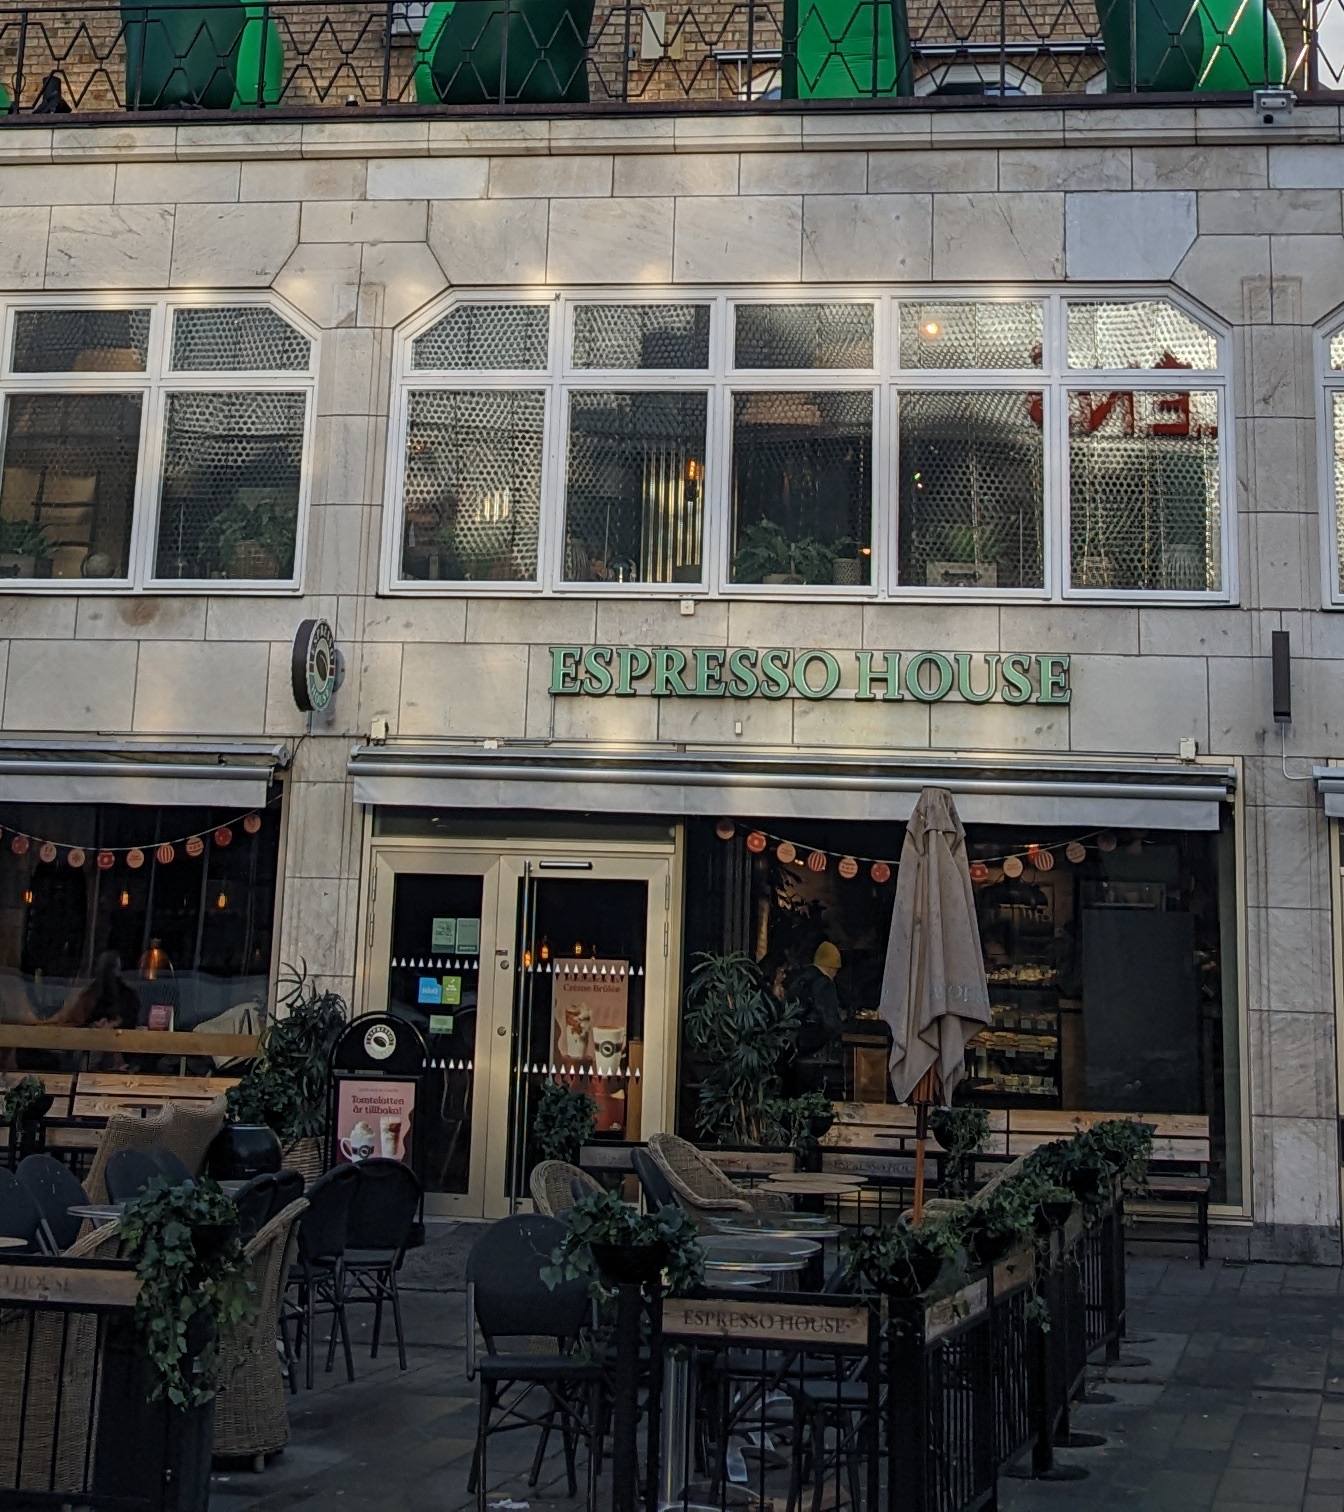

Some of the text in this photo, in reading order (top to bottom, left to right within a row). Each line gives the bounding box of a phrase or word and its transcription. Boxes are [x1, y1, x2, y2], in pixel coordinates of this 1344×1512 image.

[548, 645, 1072, 707] ESPRESSO HOUSE
[683, 1309, 848, 1334] ESPRESSO HOUSE
